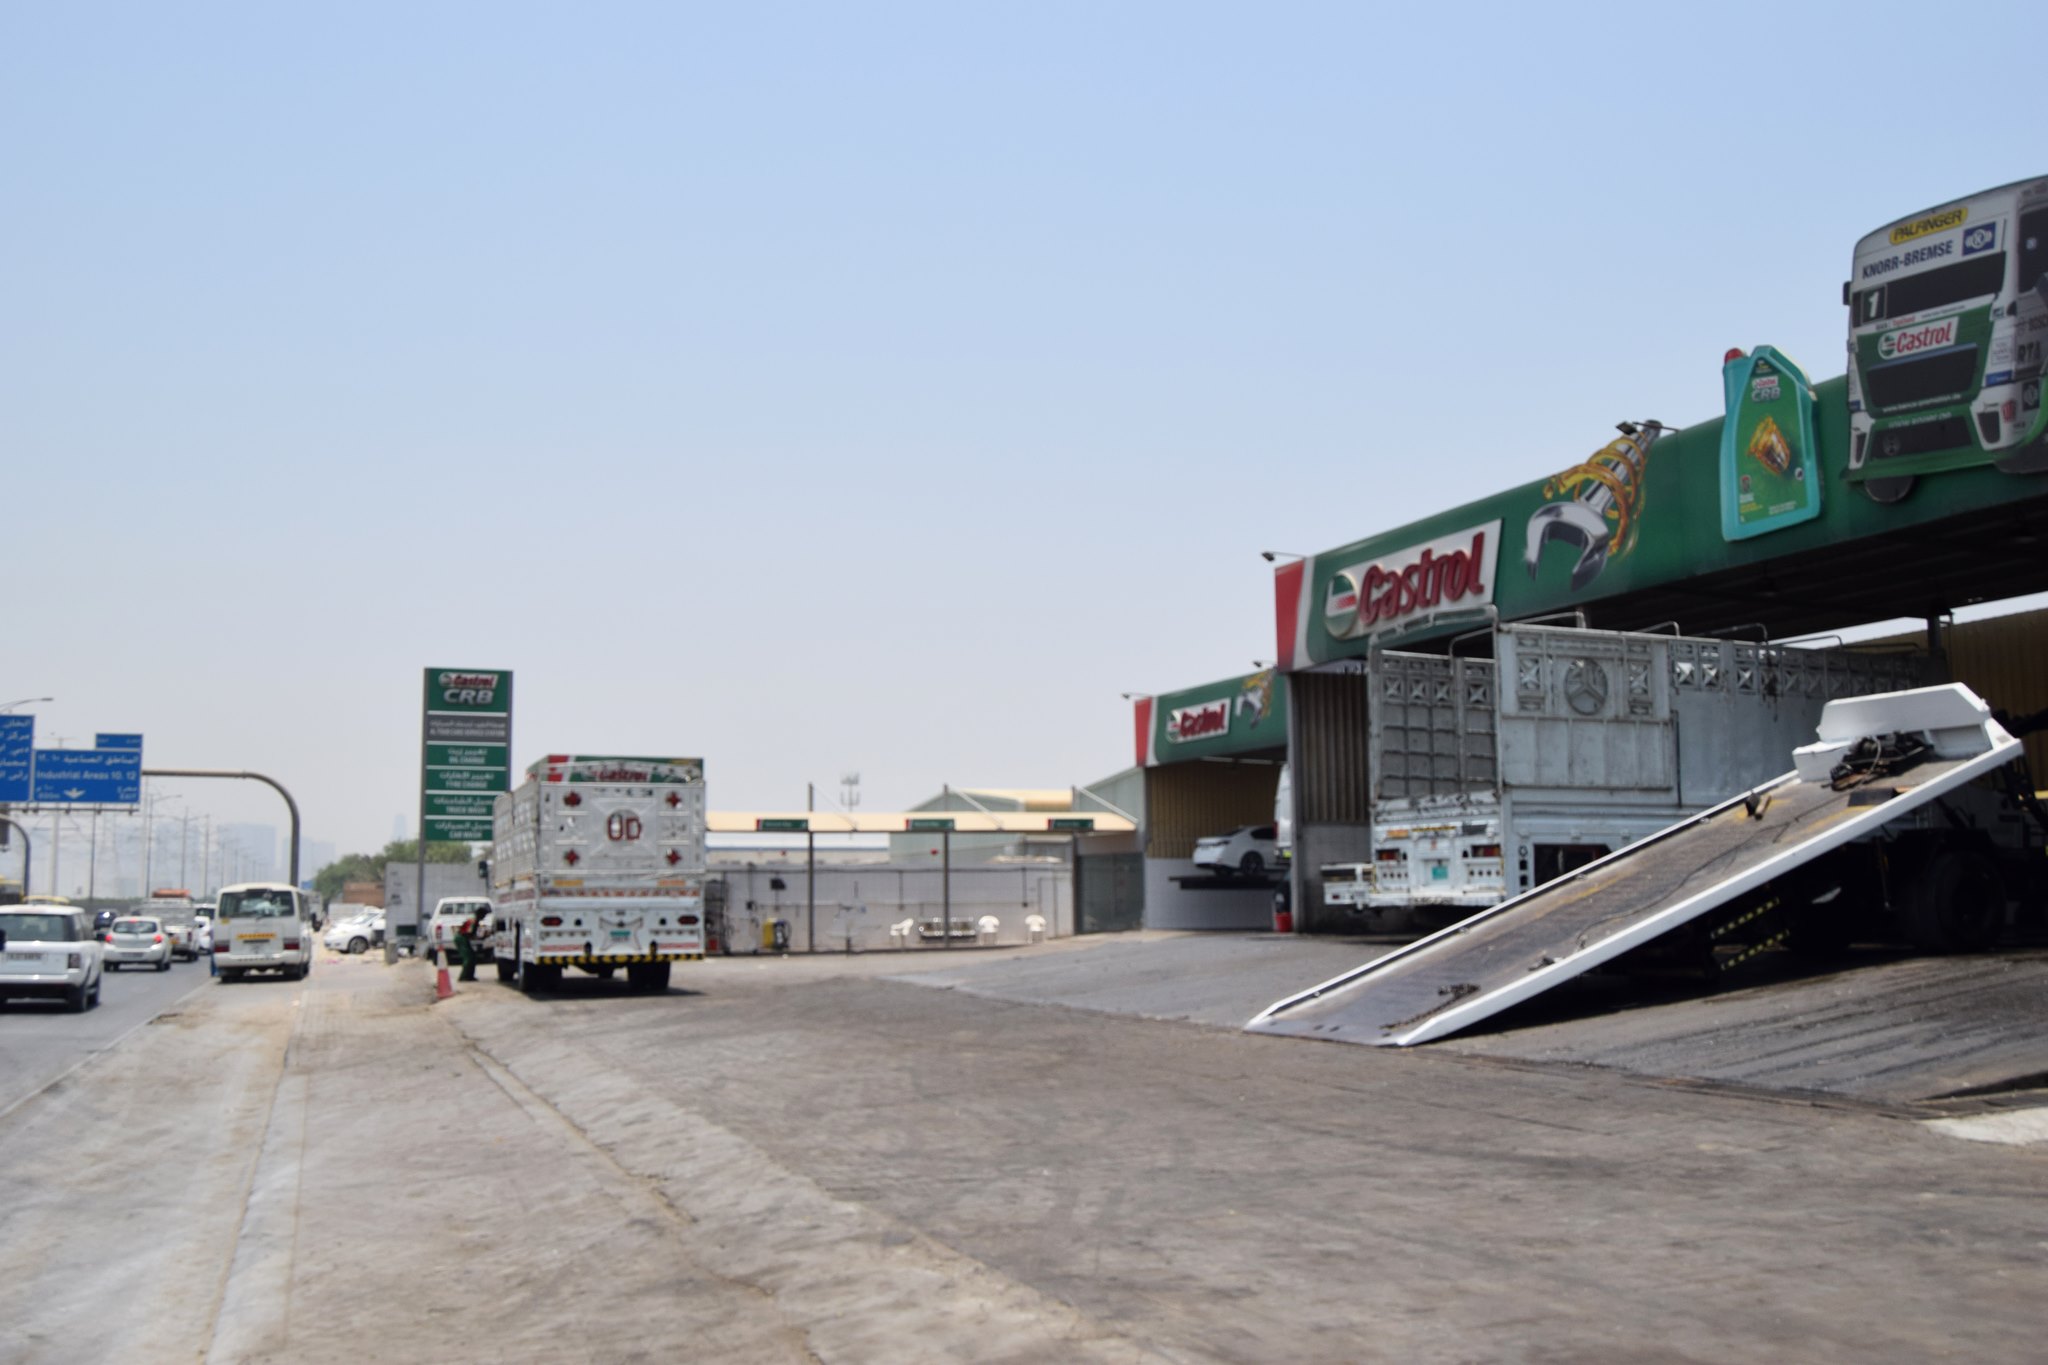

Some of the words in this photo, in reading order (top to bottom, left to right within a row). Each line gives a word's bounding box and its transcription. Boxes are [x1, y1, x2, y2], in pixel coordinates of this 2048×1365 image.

[1893, 208, 1963, 241] PALFINGER
[1862, 239, 1954, 280] KNORR-BREMSE
[1868, 290, 1880, 318] 1
[1896, 321, 1953, 353] Castrol
[1359, 531, 1486, 626] Castrol
[443, 688, 495, 704] CRB
[1180, 702, 1226, 737] Castrol
[607, 813, 642, 842] UD
